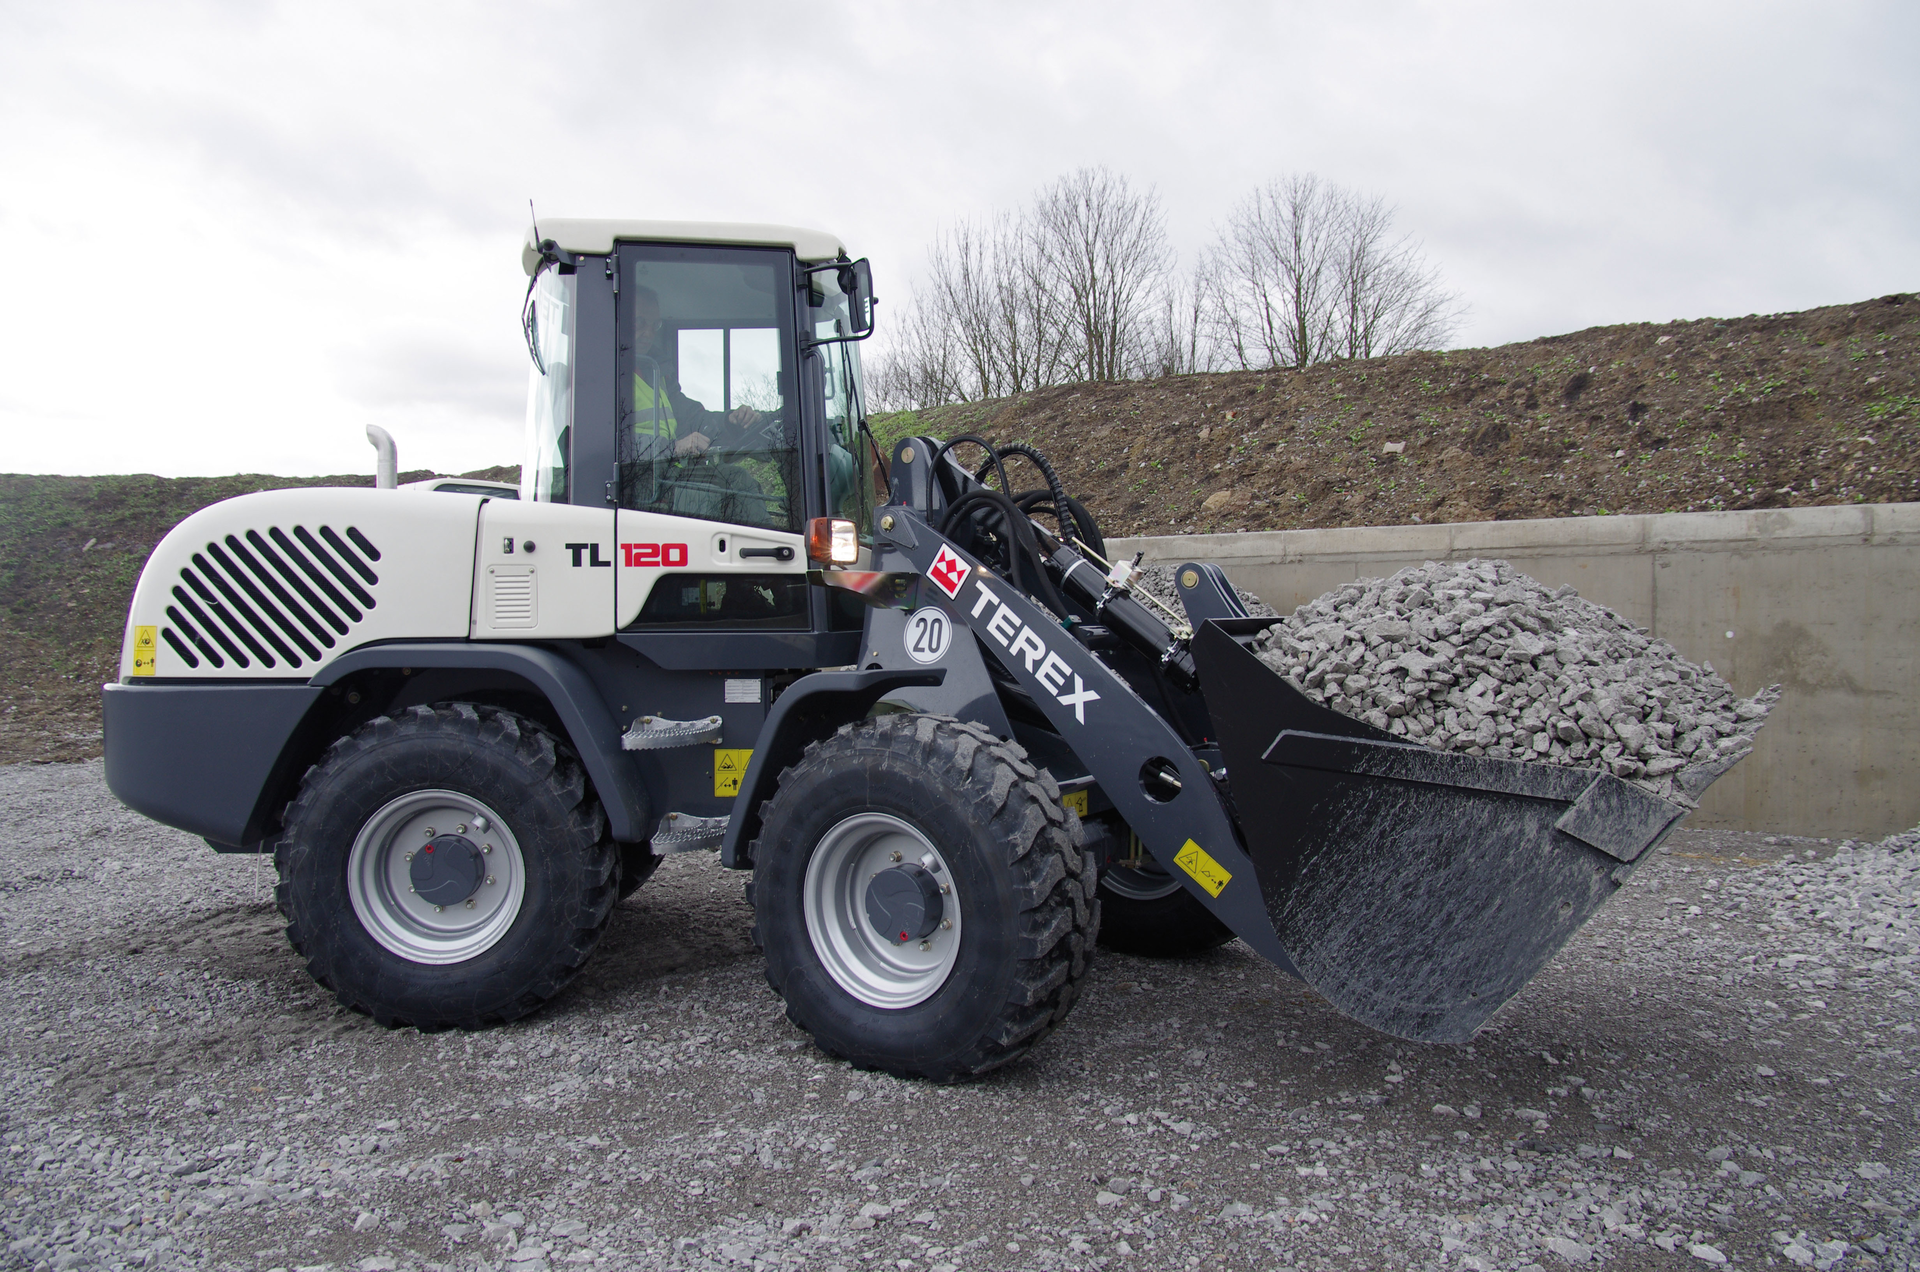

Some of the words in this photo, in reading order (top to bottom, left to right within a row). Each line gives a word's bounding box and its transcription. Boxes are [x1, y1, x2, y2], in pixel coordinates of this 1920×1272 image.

[565, 543, 611, 567] TL
[620, 543, 688, 567] 120
[913, 617, 943, 653] 20
[970, 580, 1101, 726] TEREX
